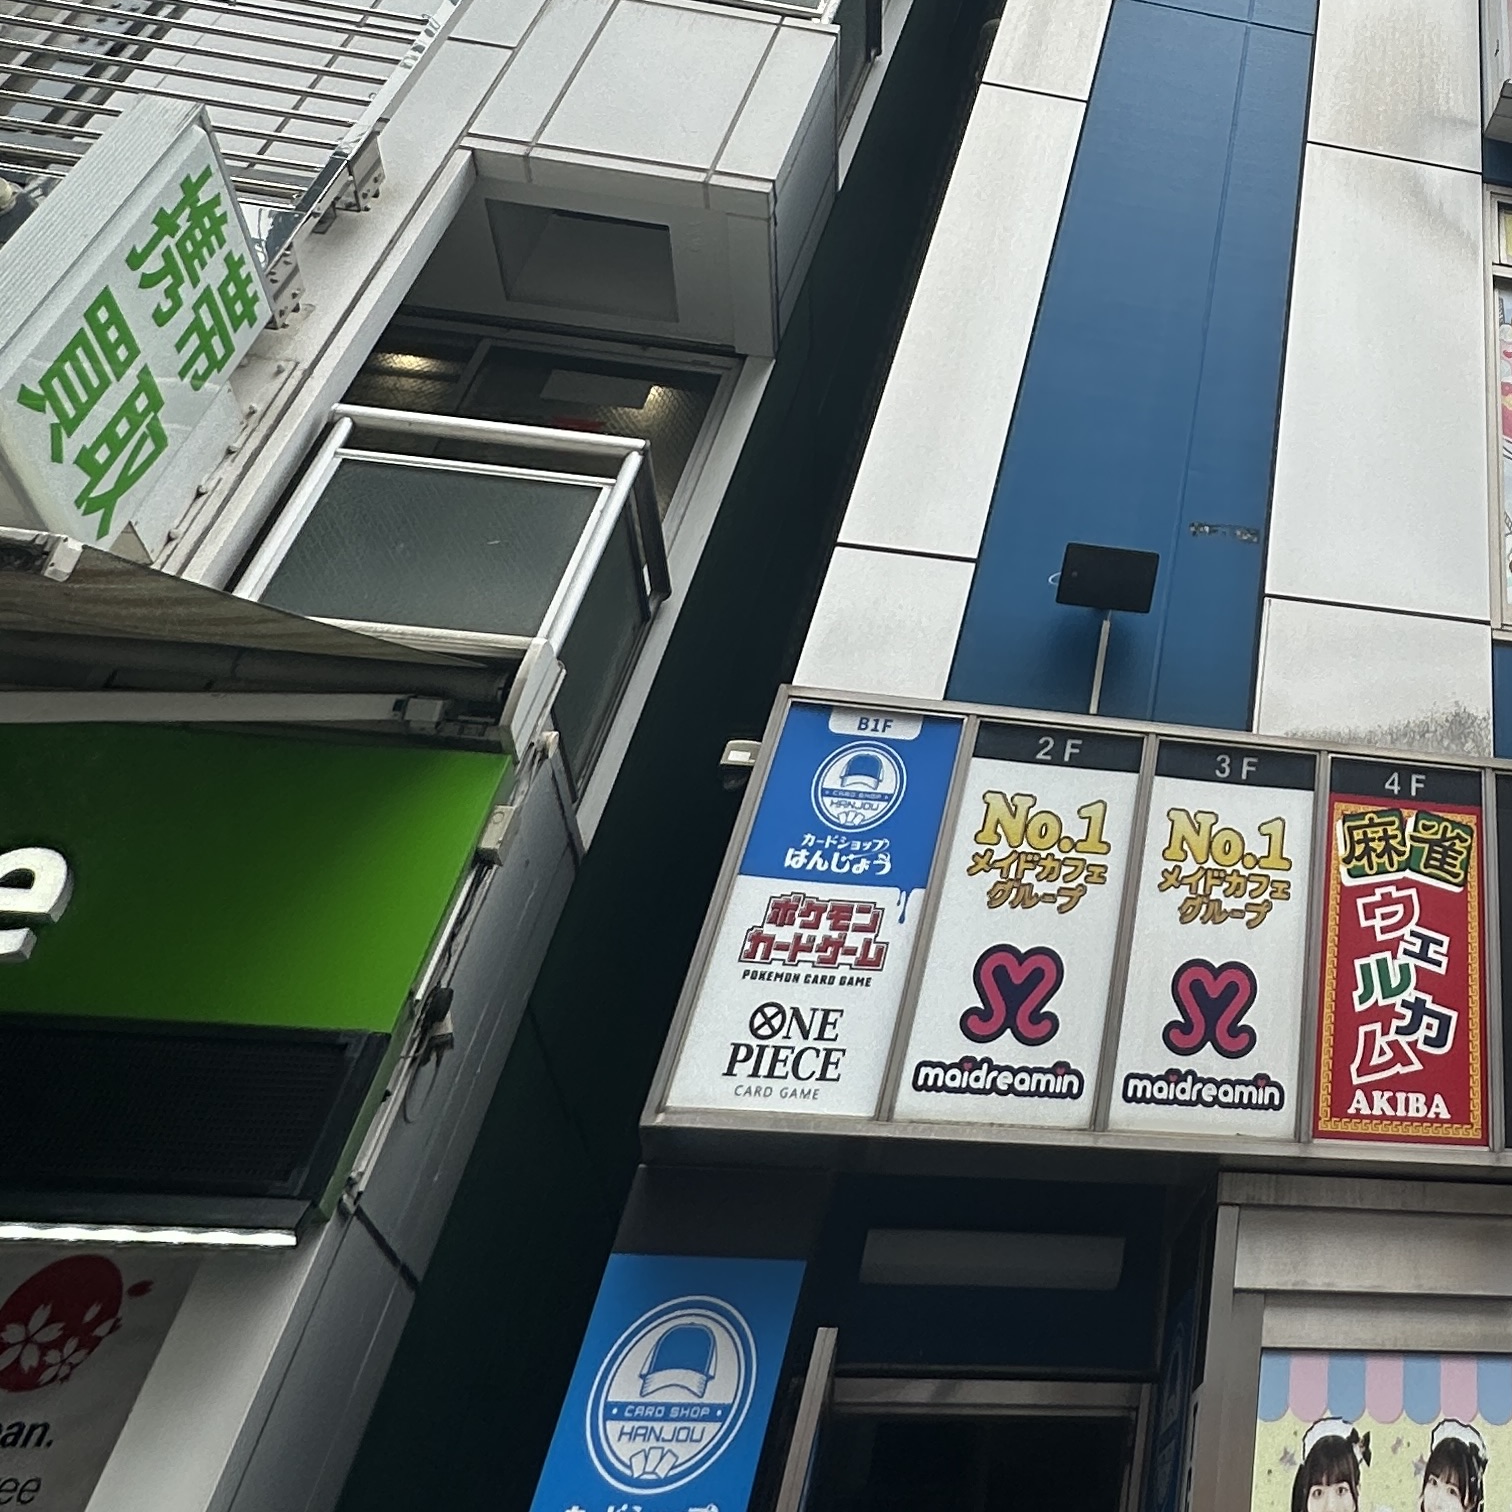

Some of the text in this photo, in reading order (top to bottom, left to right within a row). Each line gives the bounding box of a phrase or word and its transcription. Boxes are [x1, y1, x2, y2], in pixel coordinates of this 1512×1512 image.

[857, 716, 894, 734] B1F
[829, 799, 880, 812] HANJOU
[974, 790, 1111, 855] No.1
[801, 833, 890, 852] カードショップ
[1162, 807, 1293, 872] No.1
[1342, 812, 1472, 883] 麻雀
[783, 848, 892, 876] はんじょう
[966, 848, 1109, 884] メイドカフェ
[986, 878, 1087, 914] グループ
[1157, 864, 1292, 901] メイドカフェ
[766, 894, 884, 934] ポケモン
[1177, 895, 1273, 929] グループ
[742, 928, 888, 969] カードゲーム
[803, 973, 836, 986] CARD
[838, 975, 872, 988] GAME
[749, 1001, 845, 1042] ONE
[722, 1041, 847, 1083] PIECE
[914, 1056, 1083, 1099] maidreamin
[734, 1084, 820, 1101] CARD GAME
[1123, 1068, 1285, 1110] maidreamin
[1347, 1089, 1451, 1120] AKIBA
[623, 1405, 711, 1419] CARD SHOP
[0, 1420, 54, 1449] an.
[617, 1425, 706, 1444] HANJOU
